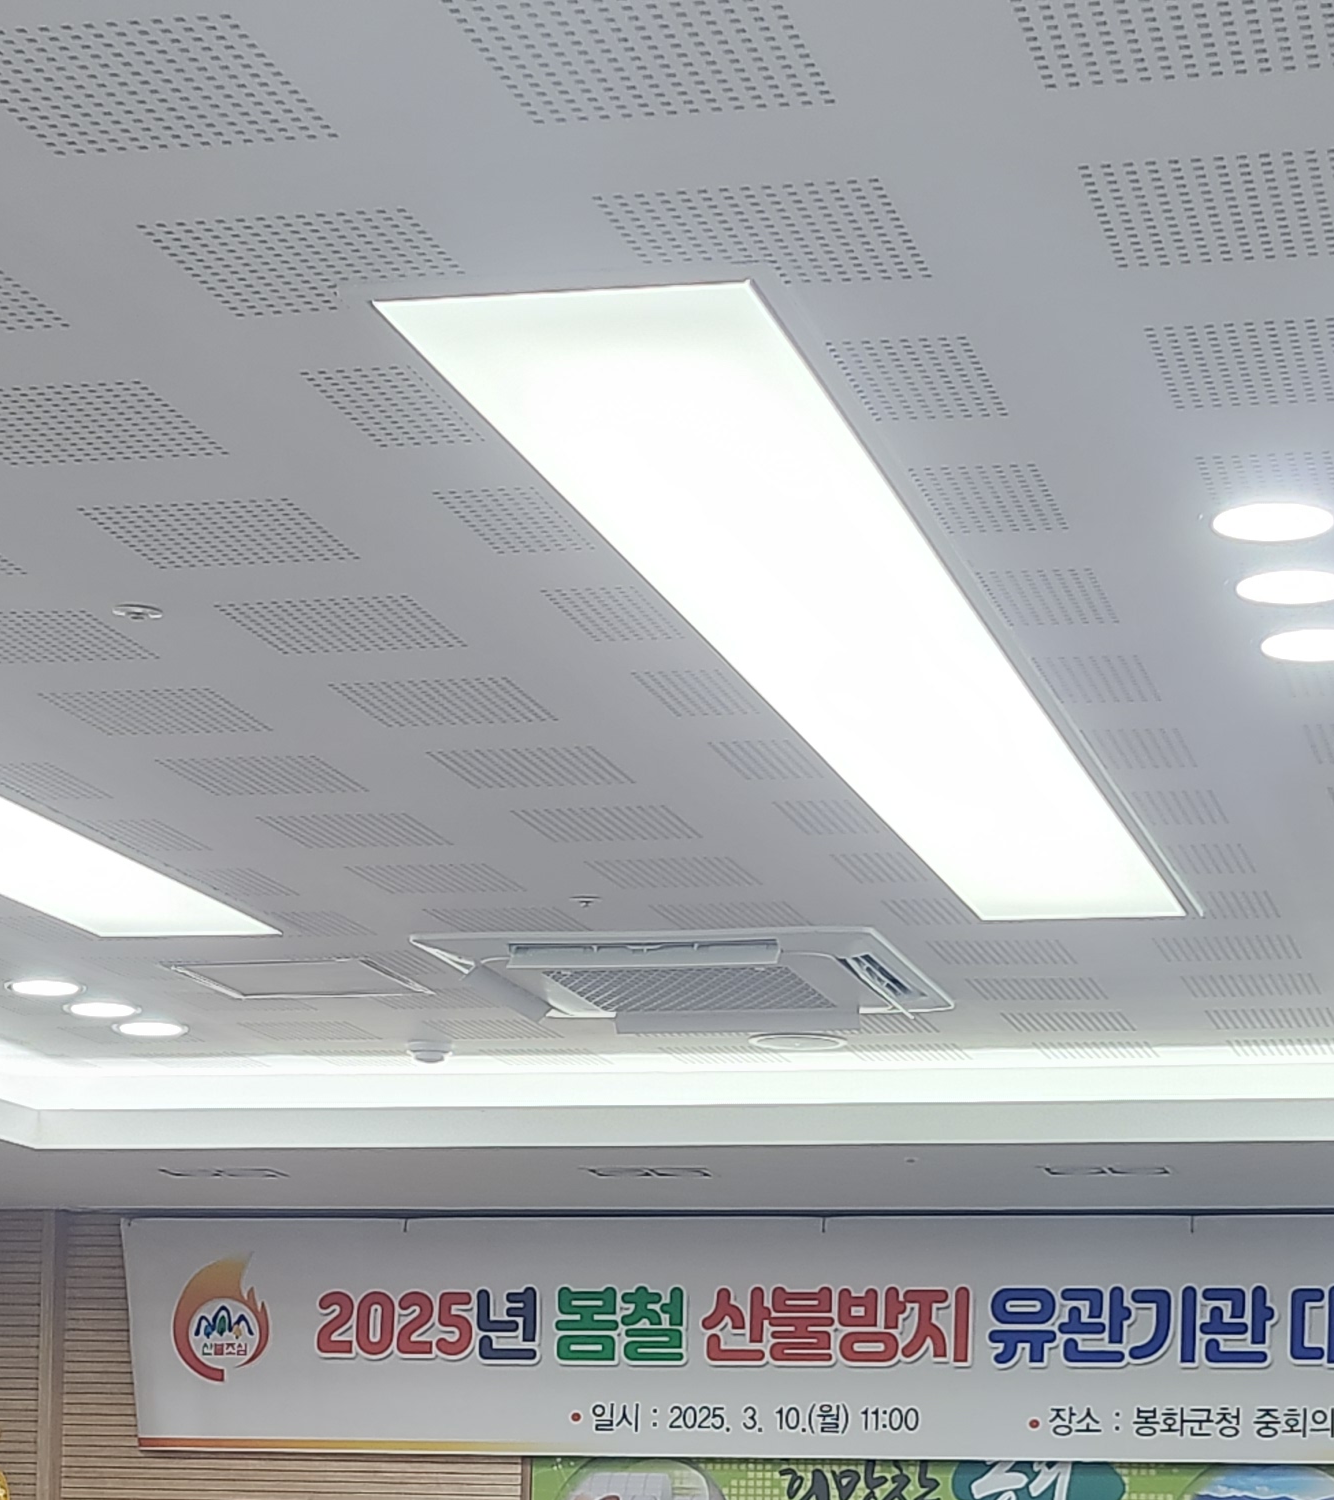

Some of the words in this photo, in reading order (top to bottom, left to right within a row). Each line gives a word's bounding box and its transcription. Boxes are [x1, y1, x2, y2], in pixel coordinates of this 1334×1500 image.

[315, 1286, 538, 1362] 2025년
[554, 1285, 685, 1362] 봄철
[700, 1285, 971, 1363] 산불방지
[987, 1285, 1275, 1364] 유관기관
[201, 1342, 248, 1356] 산불조심
[591, 1403, 640, 1433] 일시
[668, 1405, 731, 1433] 2025.
[742, 1405, 763, 1433] 3.
[774, 1402, 850, 1435] 10.(월)
[859, 1406, 920, 1432] 11:00
[1048, 1406, 1103, 1437] 장소
[1132, 1406, 1241, 1438] 봉화군청
